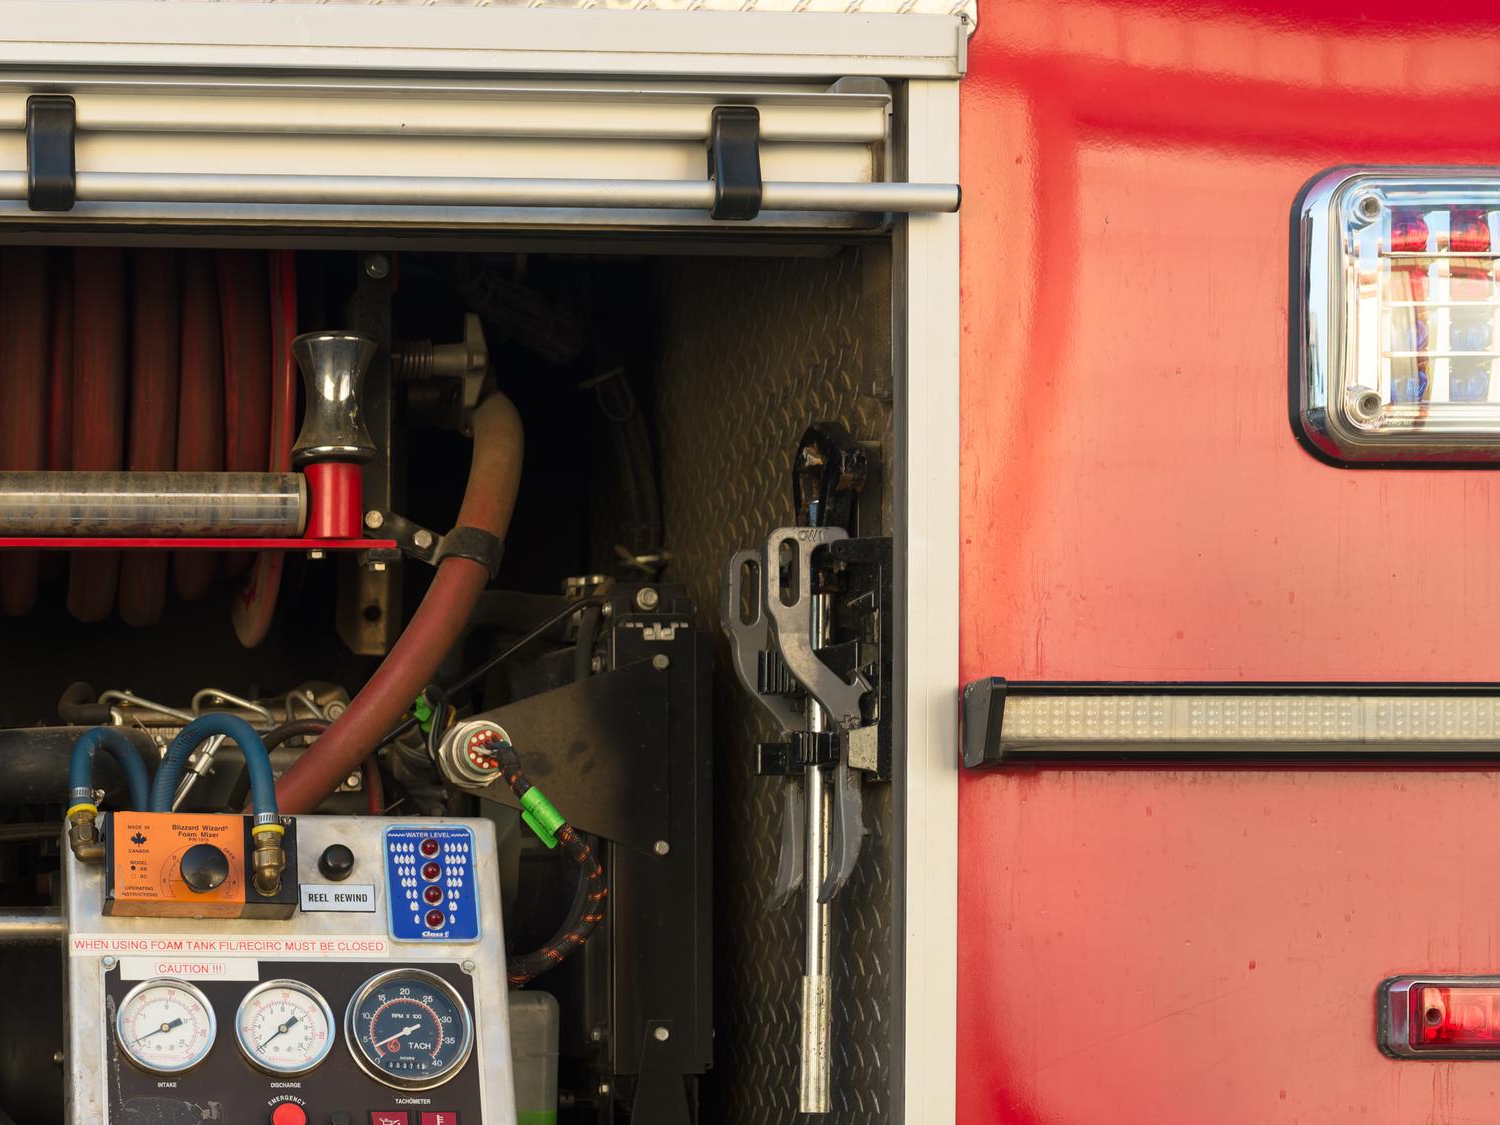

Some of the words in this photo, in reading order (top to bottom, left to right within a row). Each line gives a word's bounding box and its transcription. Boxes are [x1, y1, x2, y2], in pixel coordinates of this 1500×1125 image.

[308, 893, 330, 902] REEL
[334, 893, 368, 902] REWIND
[74, 940, 110, 950] WHEN
[111, 940, 148, 950] USING
[151, 941, 183, 950] FOAM
[185, 941, 217, 951] TANK
[219, 941, 282, 951] FIL/RECIRC
[285, 941, 317, 951] MUST
[320, 941, 334, 951] BE
[337, 942, 384, 952] CLOSED
[158, 964, 209, 974] CAUTION
[423, 995, 434, 1003] 25
[444, 1037, 455, 1045] 35
[408, 1042, 432, 1050] TACH
[267, 1095, 306, 1106] EMERGENCY
